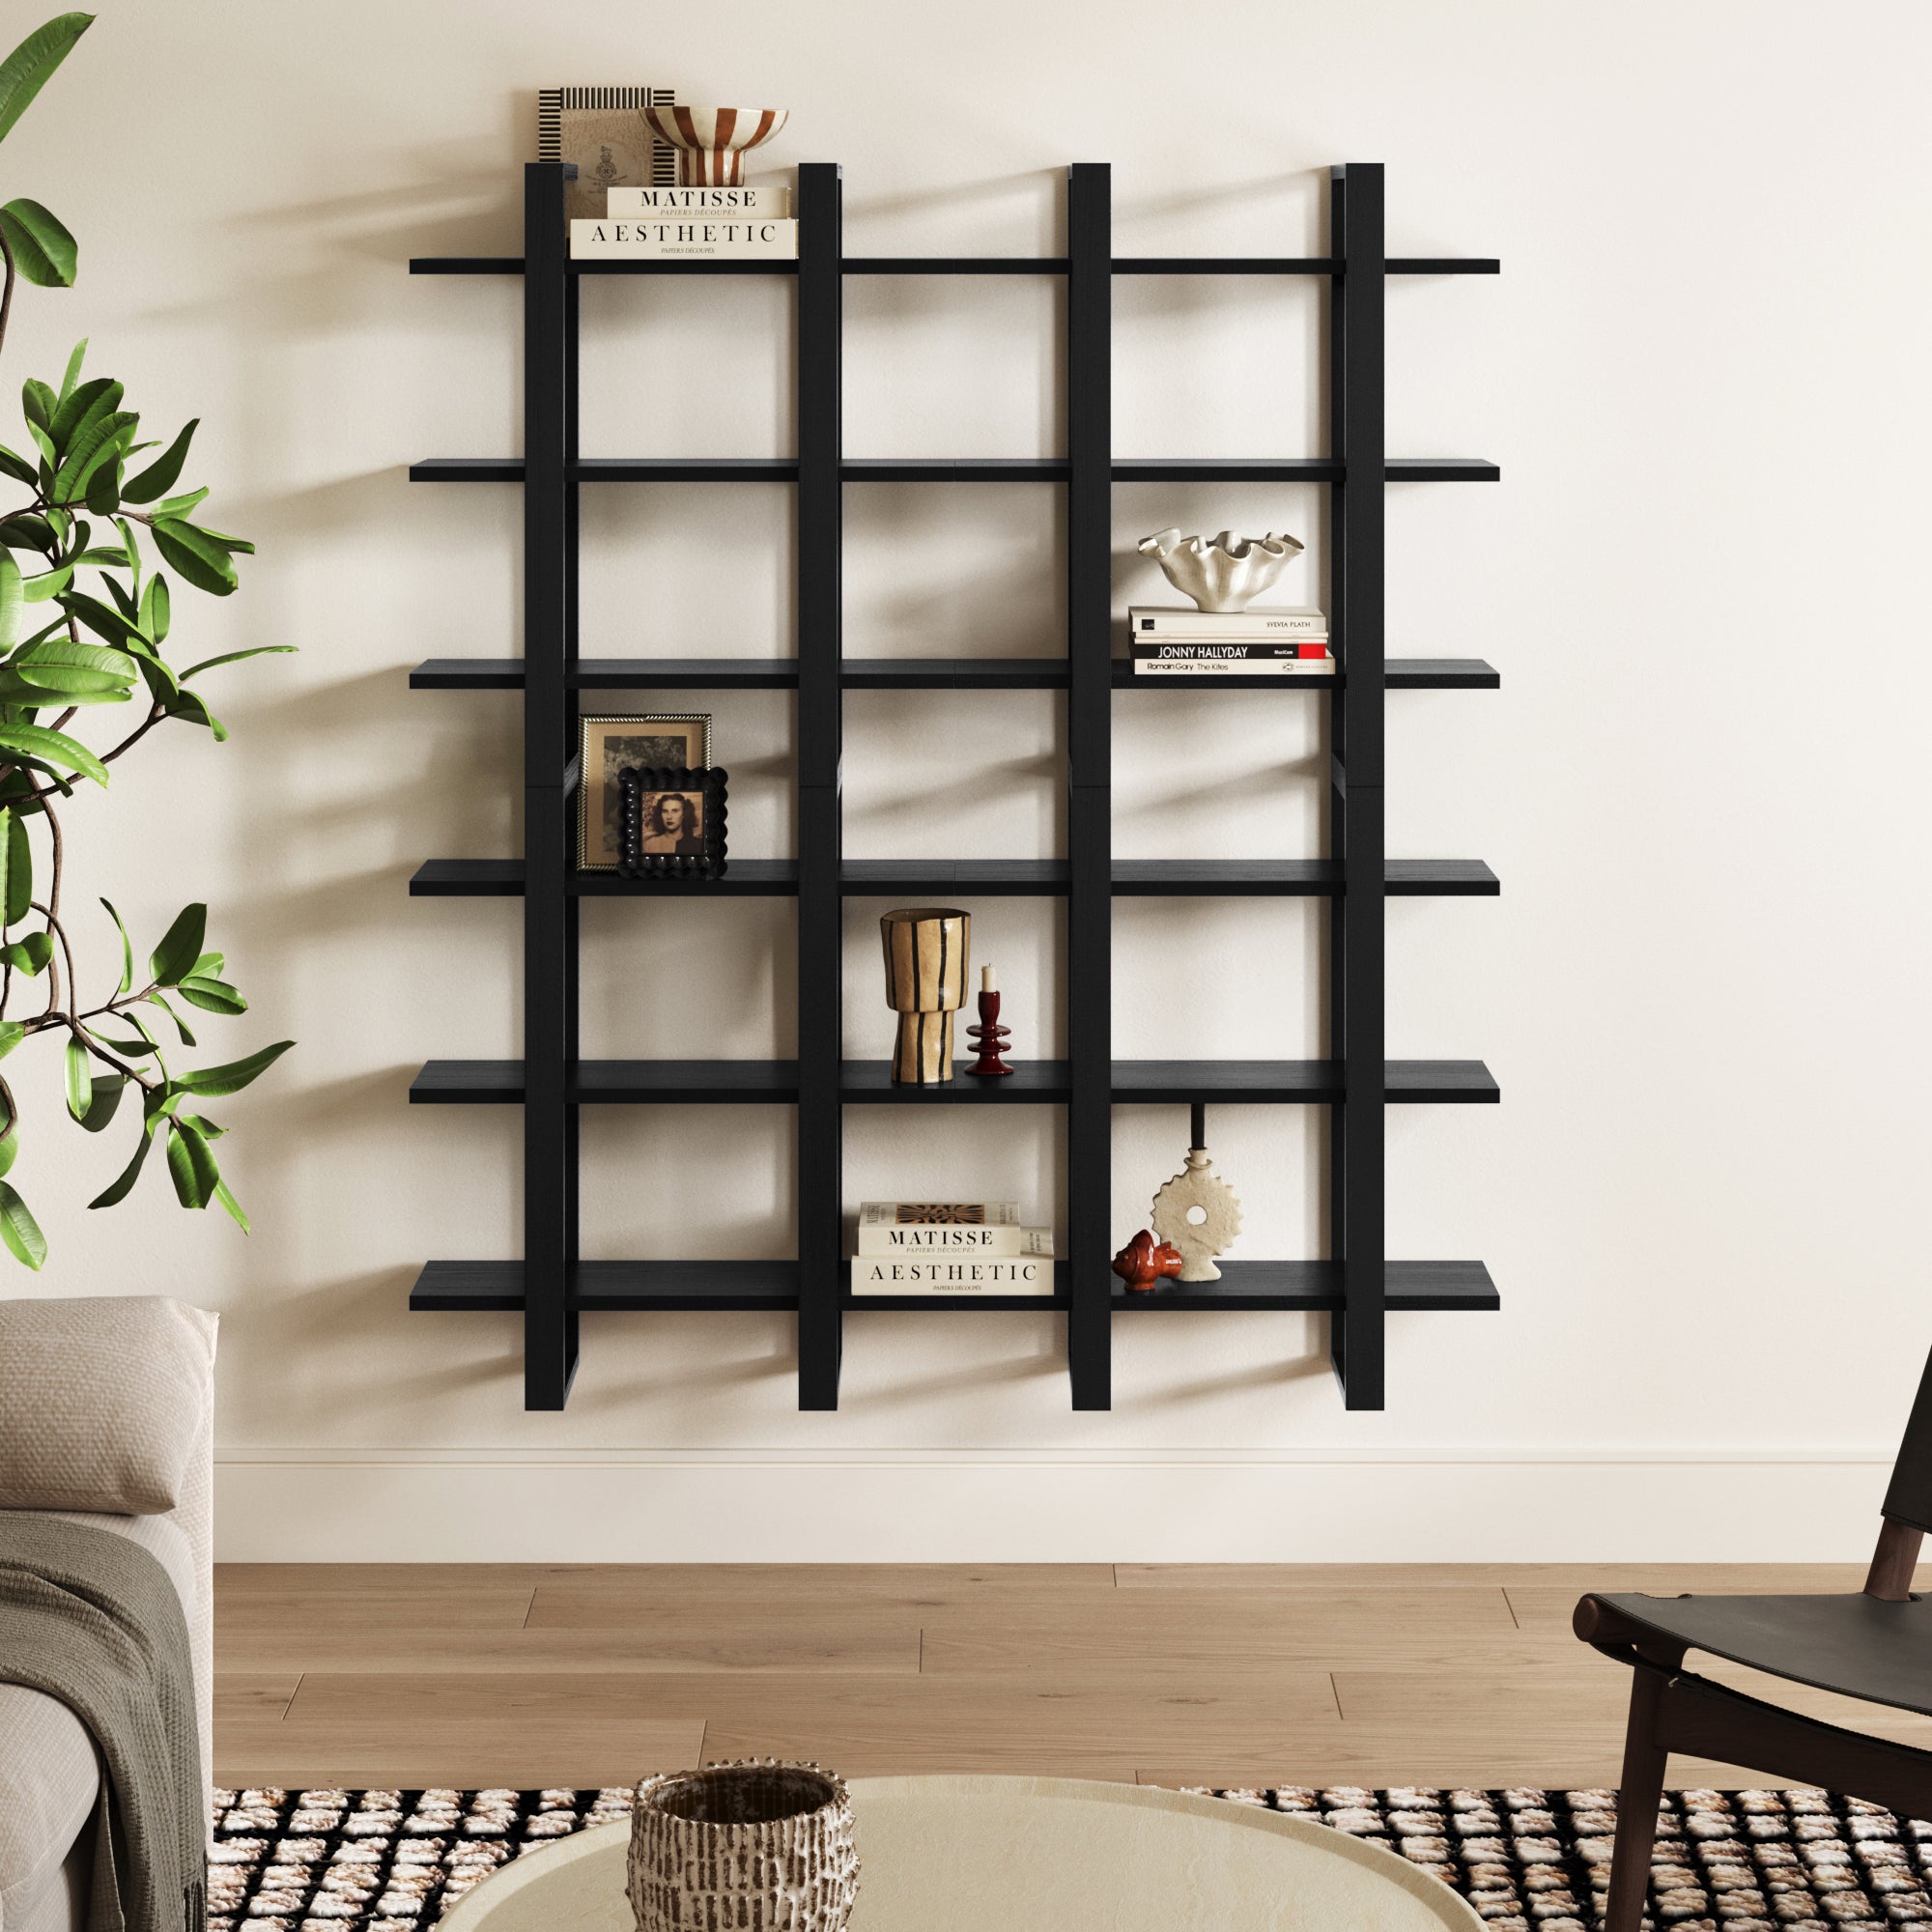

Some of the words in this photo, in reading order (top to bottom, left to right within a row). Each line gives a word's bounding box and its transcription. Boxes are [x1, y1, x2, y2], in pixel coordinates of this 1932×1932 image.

[640, 190, 756, 207] MATISSE
[694, 208, 737, 216] DÉCOUPÉS
[591, 224, 777, 242] AESTHETIC
[1157, 646, 1196, 659] JONNY
[1197, 646, 1248, 659] HALLYDAY
[1175, 663, 1194, 671] Gary
[888, 1231, 993, 1245] MATISSE
[870, 1264, 1037, 1281] AESTHETIC
